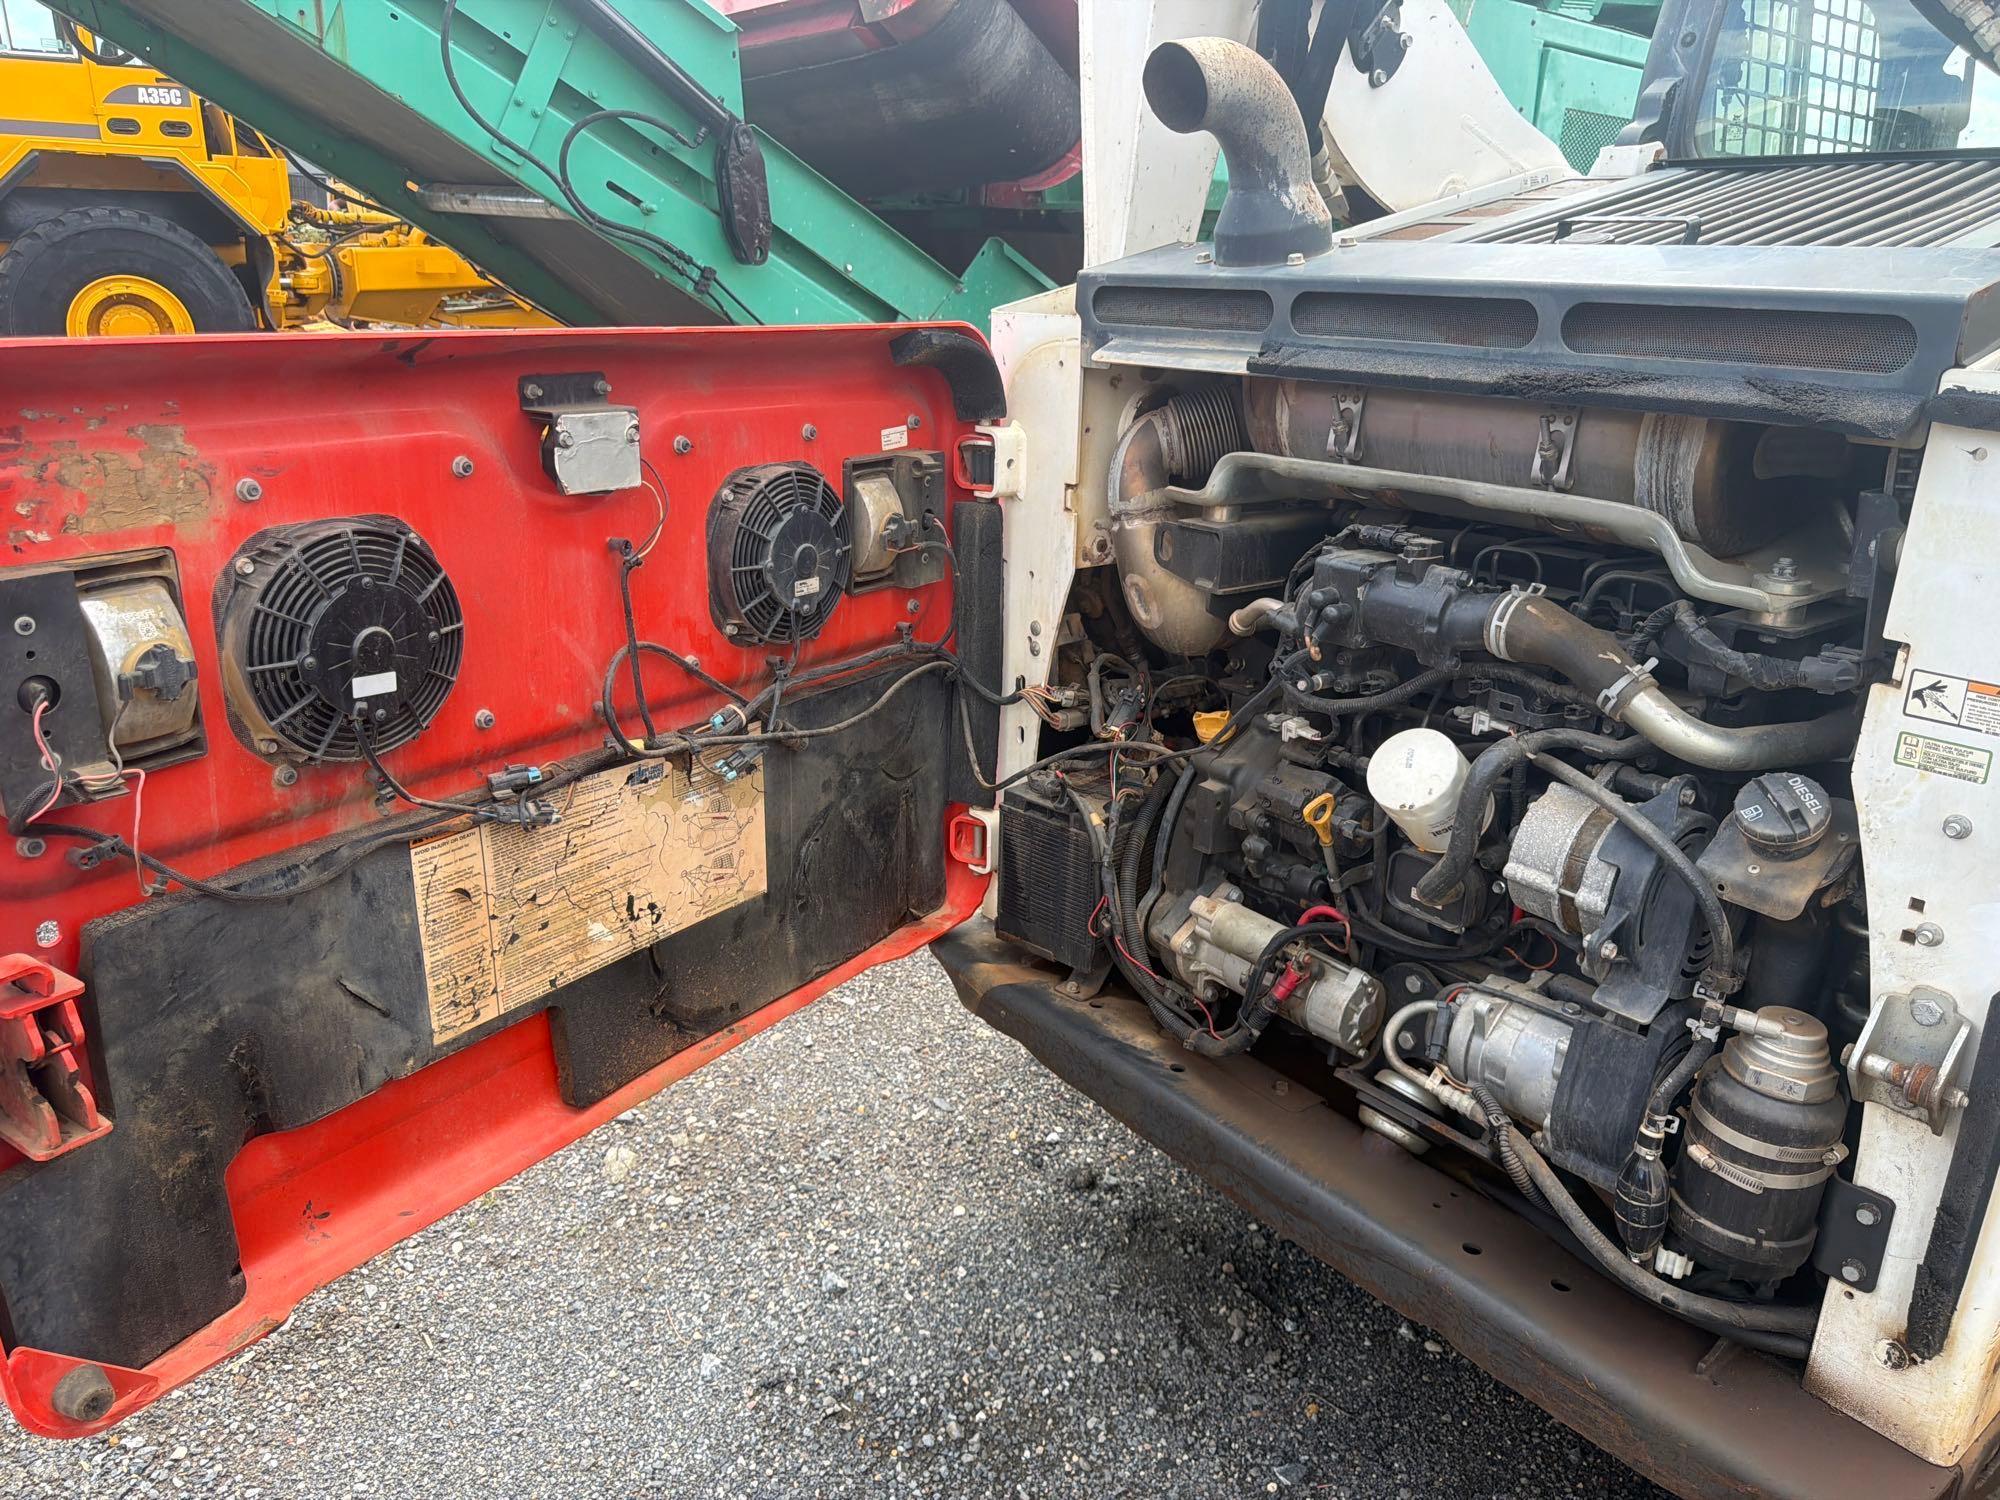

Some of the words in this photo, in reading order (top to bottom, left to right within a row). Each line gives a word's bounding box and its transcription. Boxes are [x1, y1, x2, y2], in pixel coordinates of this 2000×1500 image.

[138, 87, 182, 105] A35C
[1788, 777, 1822, 814] DIESEL
[414, 848, 430, 856] AVOID
[431, 840, 450, 850] INJURY
[459, 832, 476, 841] DEATH
